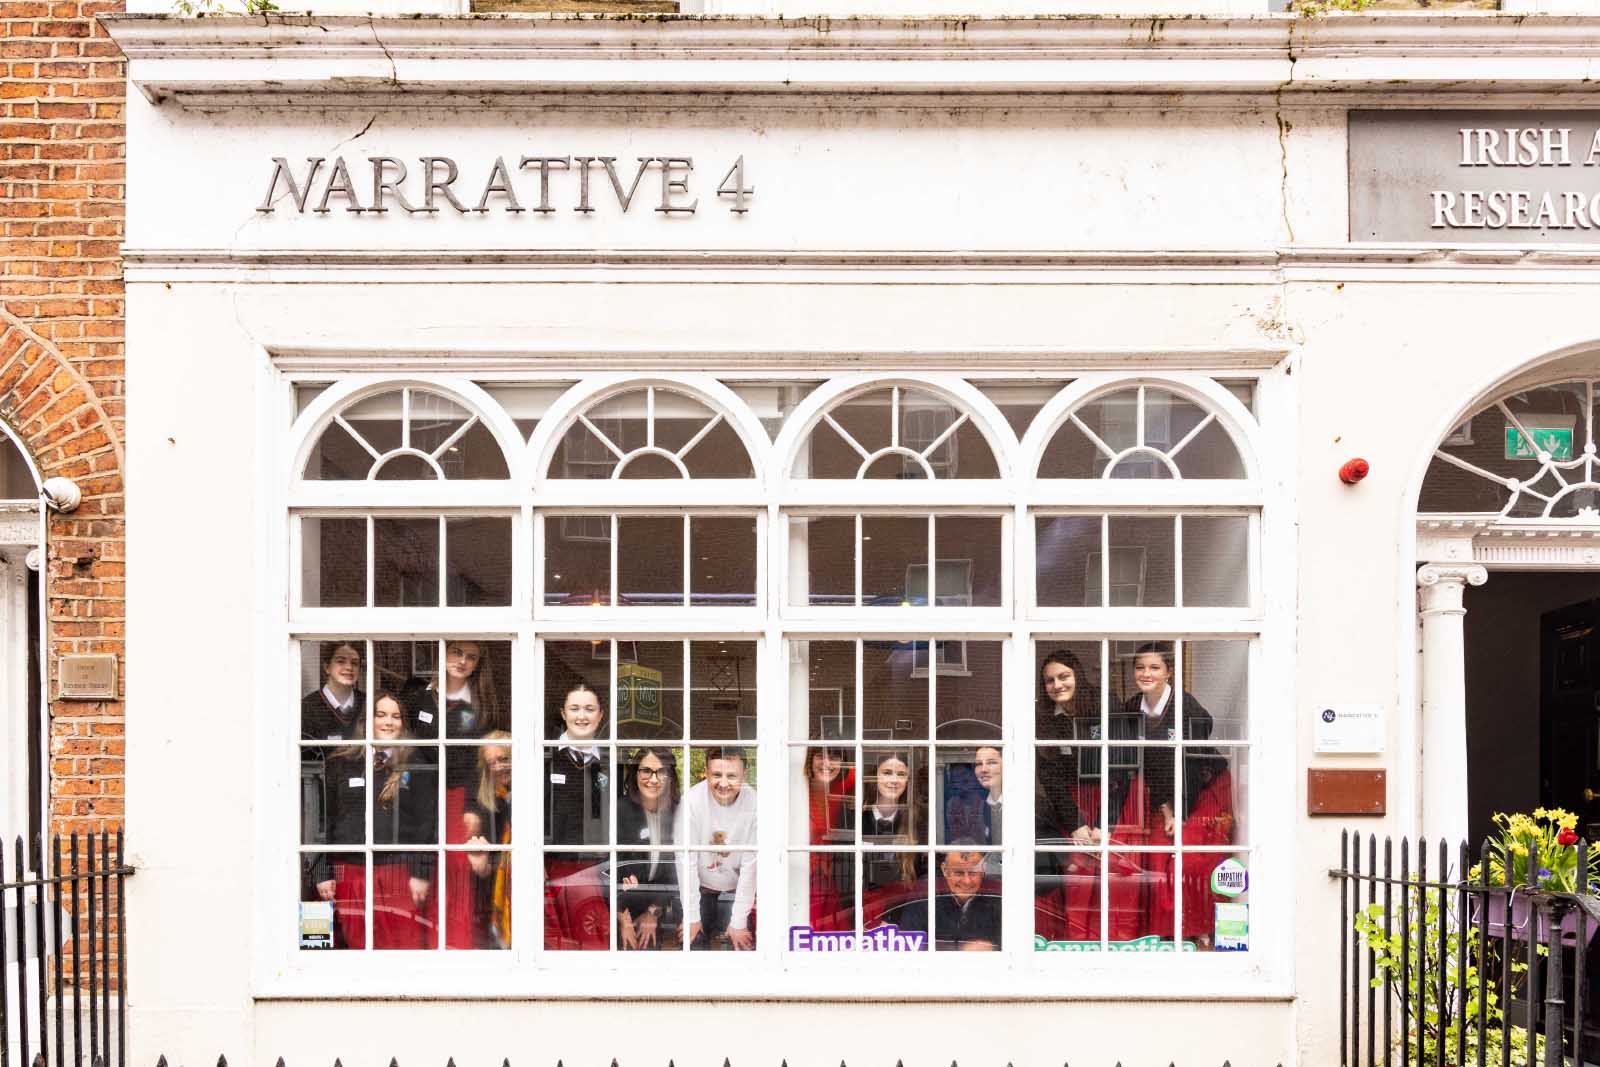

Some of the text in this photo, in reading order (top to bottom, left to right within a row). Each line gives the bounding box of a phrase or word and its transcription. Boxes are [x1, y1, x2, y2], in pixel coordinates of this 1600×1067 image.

[1459, 128, 1572, 166] IRISH
[256, 155, 755, 213] NARRATIVE 4
[1217, 872, 1243, 881] EMPATHY
[792, 929, 924, 951] Empathy
